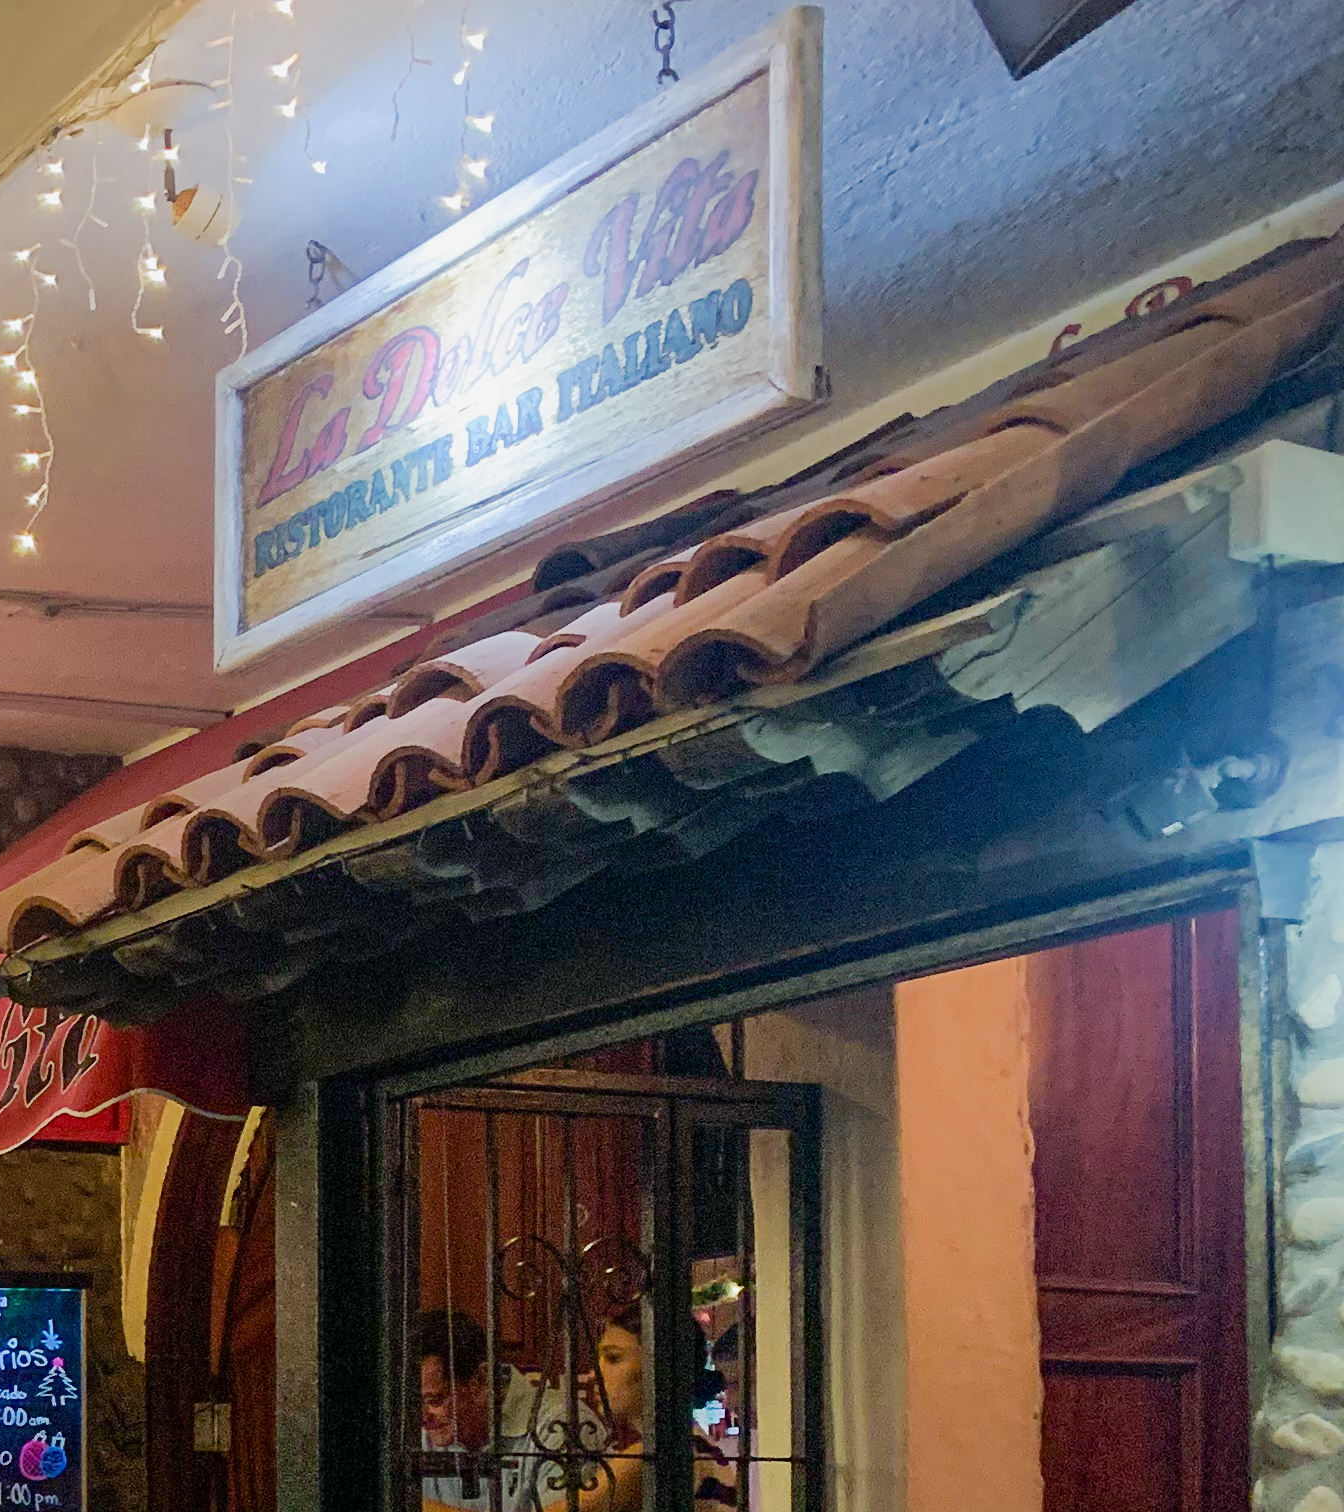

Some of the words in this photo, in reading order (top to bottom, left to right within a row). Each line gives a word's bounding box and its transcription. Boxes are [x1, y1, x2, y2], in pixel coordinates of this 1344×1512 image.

[254, 435, 453, 577] RISTORANTE
[465, 386, 543, 466] BAR
[557, 278, 754, 421] ITALIANO
[255, 374, 351, 507] La
[359, 258, 570, 448] Dolce
[583, 150, 759, 327] Vita
